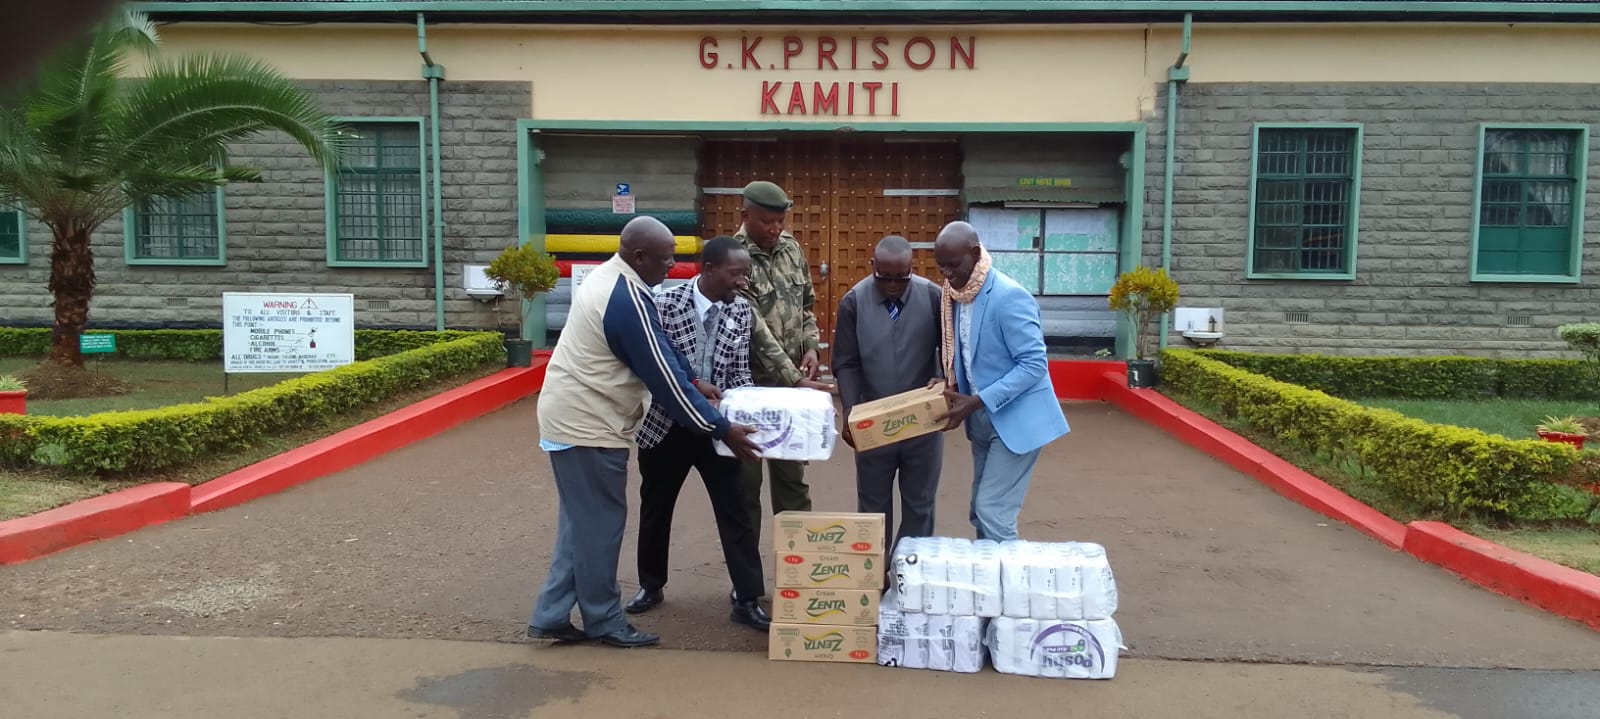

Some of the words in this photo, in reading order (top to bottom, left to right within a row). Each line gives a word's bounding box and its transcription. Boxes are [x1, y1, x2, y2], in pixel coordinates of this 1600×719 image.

[699, 36, 976, 70] G.K.PRISON
[761, 80, 899, 116] KAMITI
[263, 301, 298, 309] WARNING
[882, 413, 918, 433] ZENTA
[806, 531, 846, 544] ZENTA
[811, 563, 850, 576] ZENTA
[807, 598, 846, 610] ZENTA
[804, 639, 843, 651] ZENTA
